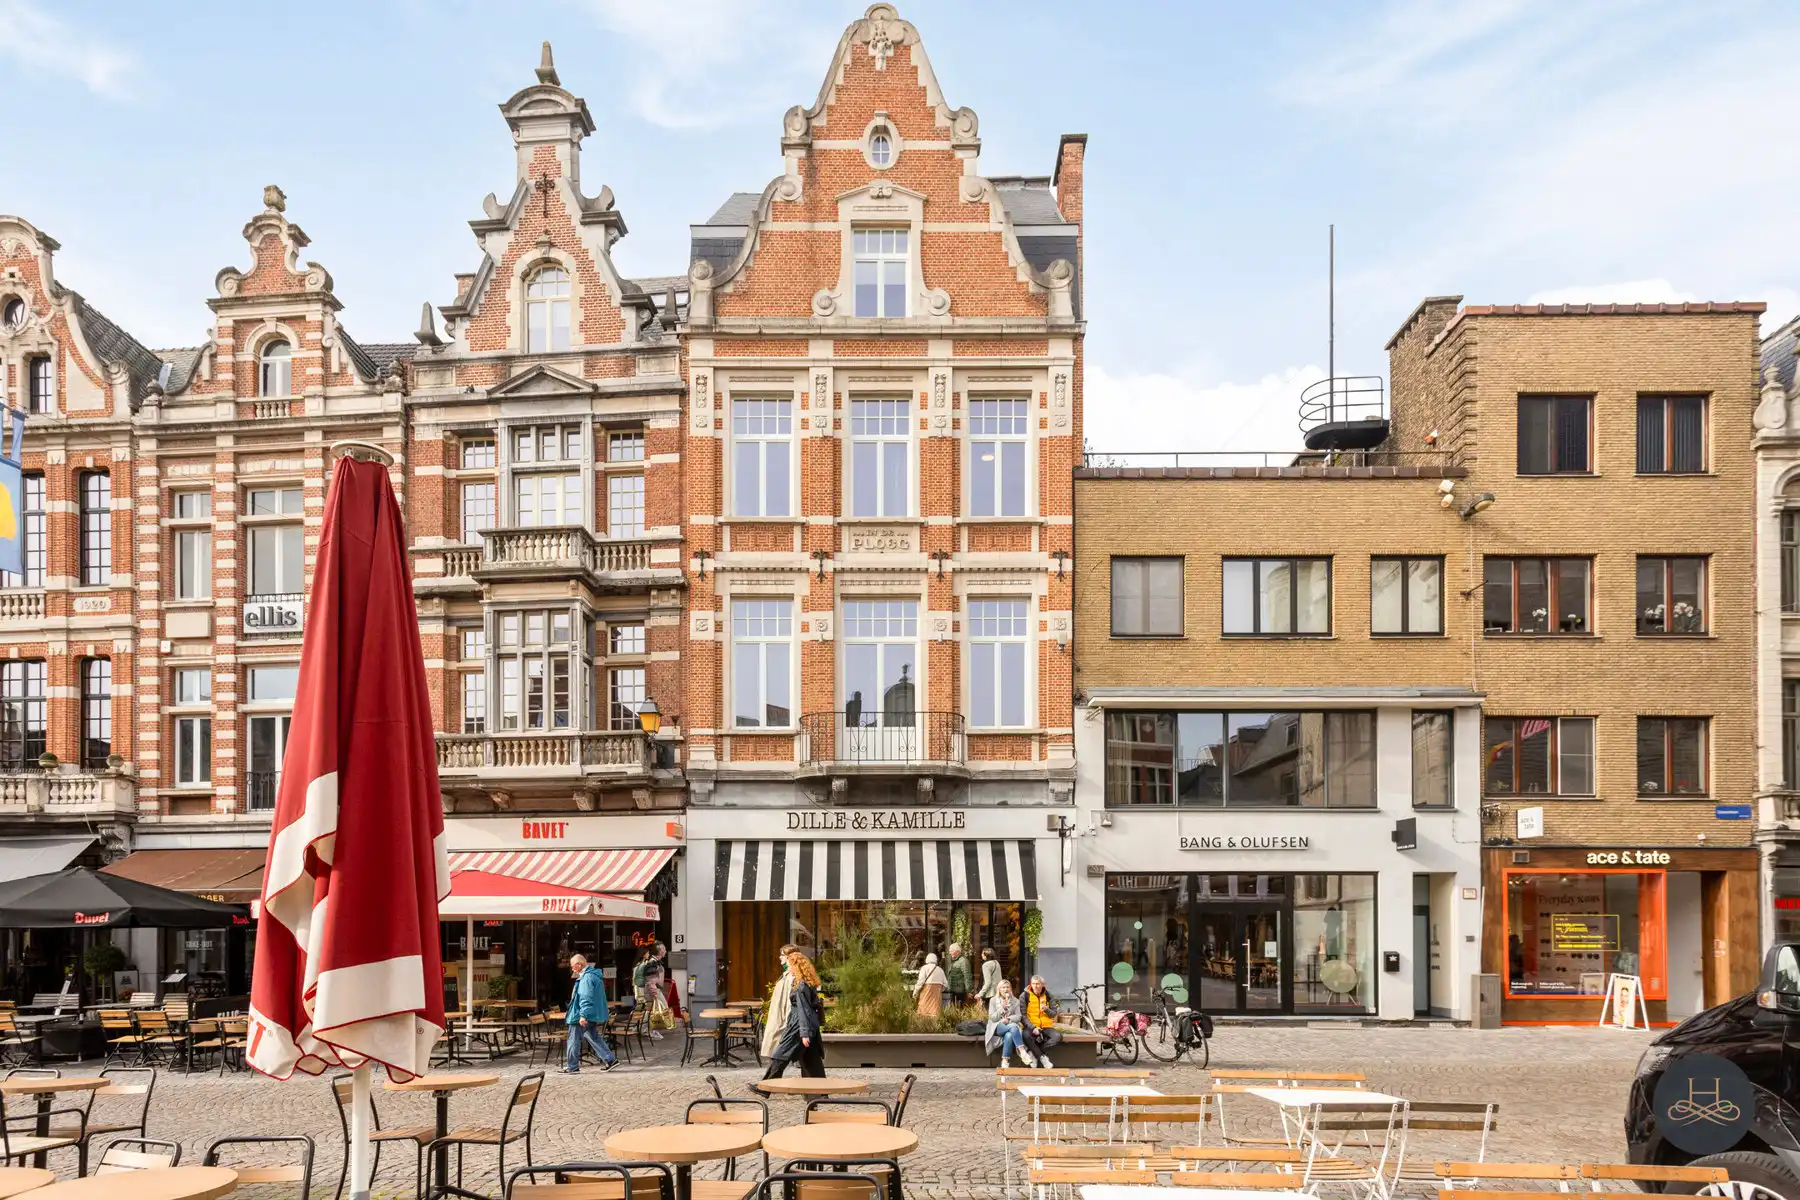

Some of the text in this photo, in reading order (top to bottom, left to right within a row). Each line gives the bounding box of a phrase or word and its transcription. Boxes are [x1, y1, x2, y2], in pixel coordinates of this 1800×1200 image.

[244, 605, 298, 628] ellis
[787, 811, 966, 830] DILLE & KAMILLE
[522, 822, 565, 839] BAVET
[1180, 836, 1309, 848] BANG & OLUFSEN
[1586, 850, 1671, 865] ace & tate
[542, 898, 577, 912] BAVET
[75, 911, 110, 924] Duvel
[460, 936, 490, 950] BVET
[675, 935, 684, 943] 8
